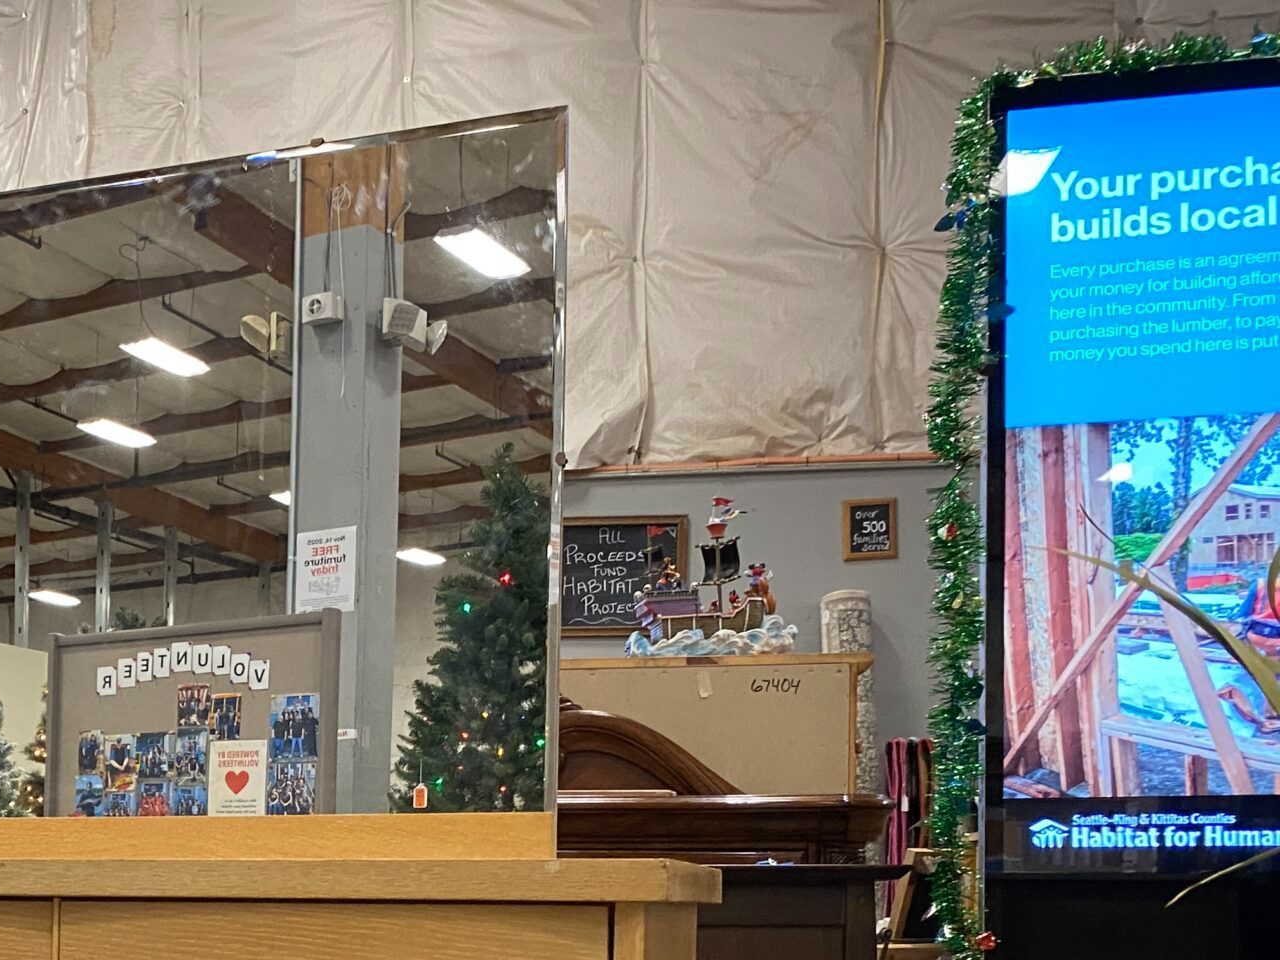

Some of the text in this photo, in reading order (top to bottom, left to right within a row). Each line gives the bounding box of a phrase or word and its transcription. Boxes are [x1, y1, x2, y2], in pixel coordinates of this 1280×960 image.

[1051, 171, 1142, 201] Your
[1051, 195, 1277, 243] builds local
[1050, 264, 1096, 280] Every
[1099, 257, 1175, 277] purchase
[1178, 256, 1191, 269] is
[1195, 254, 1215, 267] an
[1049, 286, 1086, 302] your
[1088, 281, 1144, 297] money
[1147, 278, 1169, 292] for
[1173, 273, 1236, 291] building
[1049, 293, 1276, 320] here in the community. From
[1049, 323, 1139, 343] purchasing
[1142, 321, 1169, 335] the
[1171, 317, 1232, 333] lumber,
[1235, 315, 1252, 328] to
[1049, 334, 1279, 362] money you spend here is put
[599, 527, 626, 544] ALL
[862, 520, 886, 533] 500
[852, 533, 888, 545] families
[564, 543, 645, 565] PROCEEDS
[589, 563, 627, 577] FUND
[562, 576, 639, 596] HABITAT
[750, 678, 801, 695] 67404
[1139, 814, 1150, 825] &
[1151, 814, 1189, 825] Kittitas
[1190, 813, 1236, 825] Counties
[1071, 826, 1160, 848] Habitat
[1163, 826, 1202, 848] for
